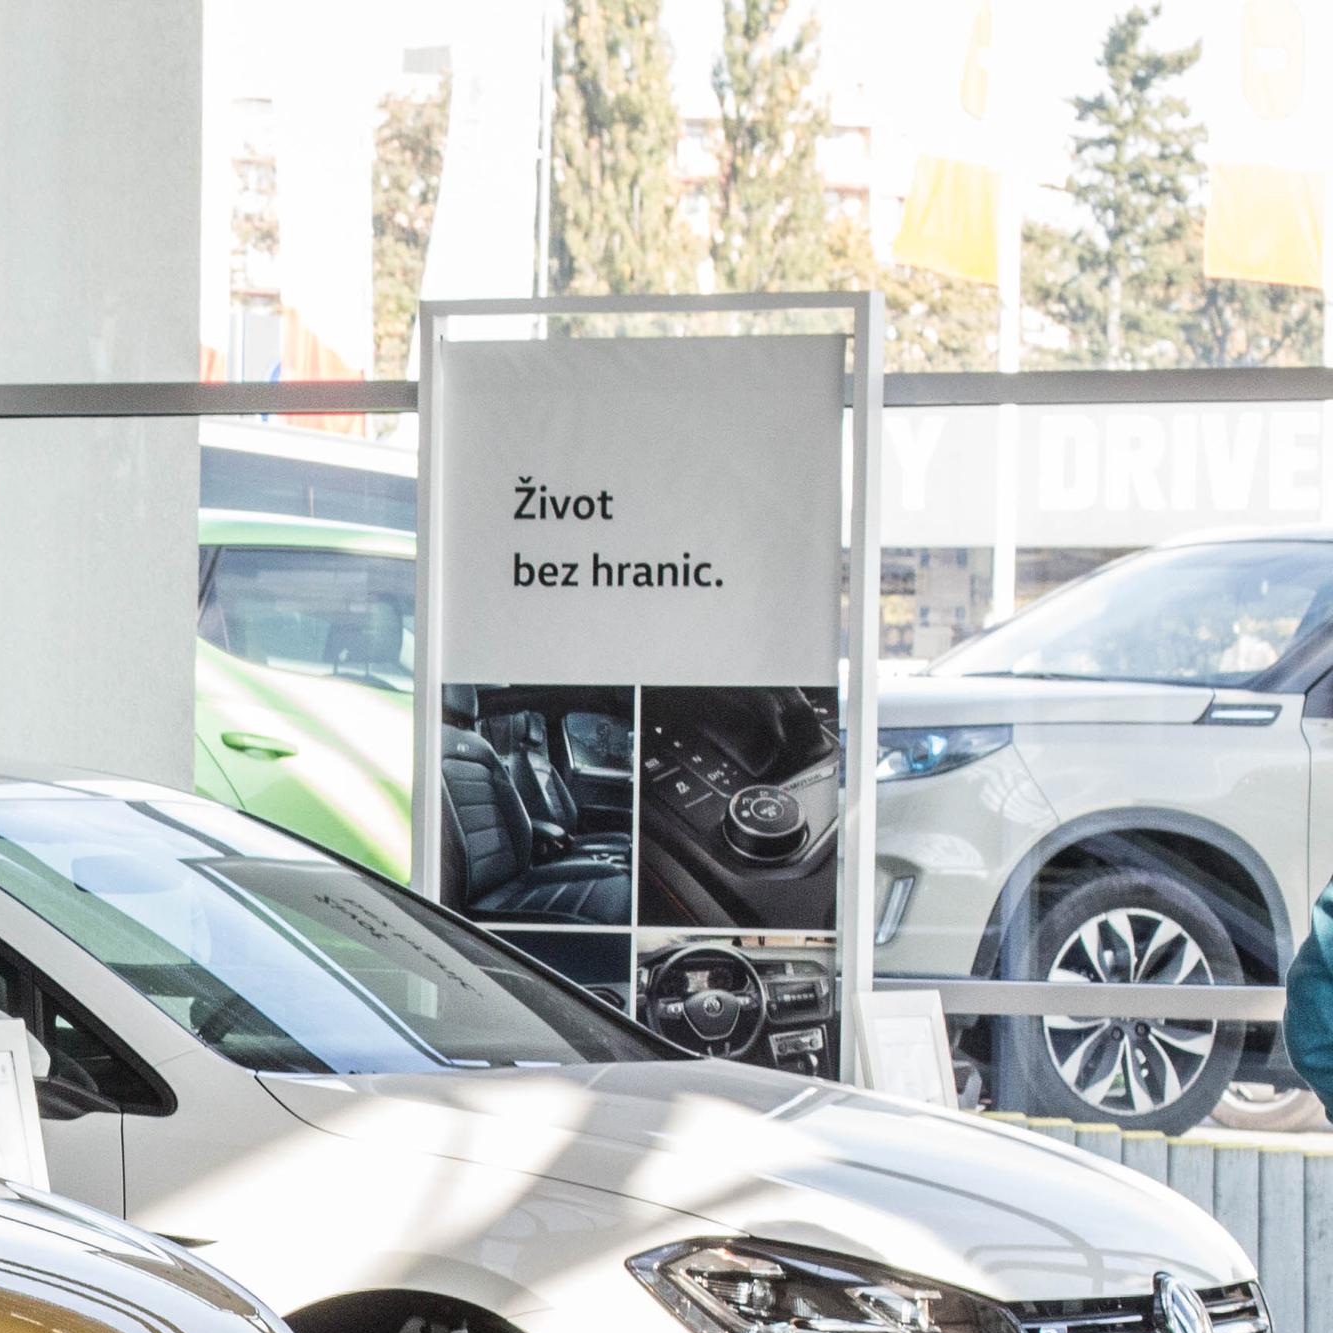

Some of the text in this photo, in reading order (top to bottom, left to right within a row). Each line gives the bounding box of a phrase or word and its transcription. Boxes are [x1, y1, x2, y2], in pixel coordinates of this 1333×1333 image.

[1038, 410, 1321, 512] DRIVE
[513, 475, 614, 520] Život
[513, 552, 723, 588] bez hranic.
